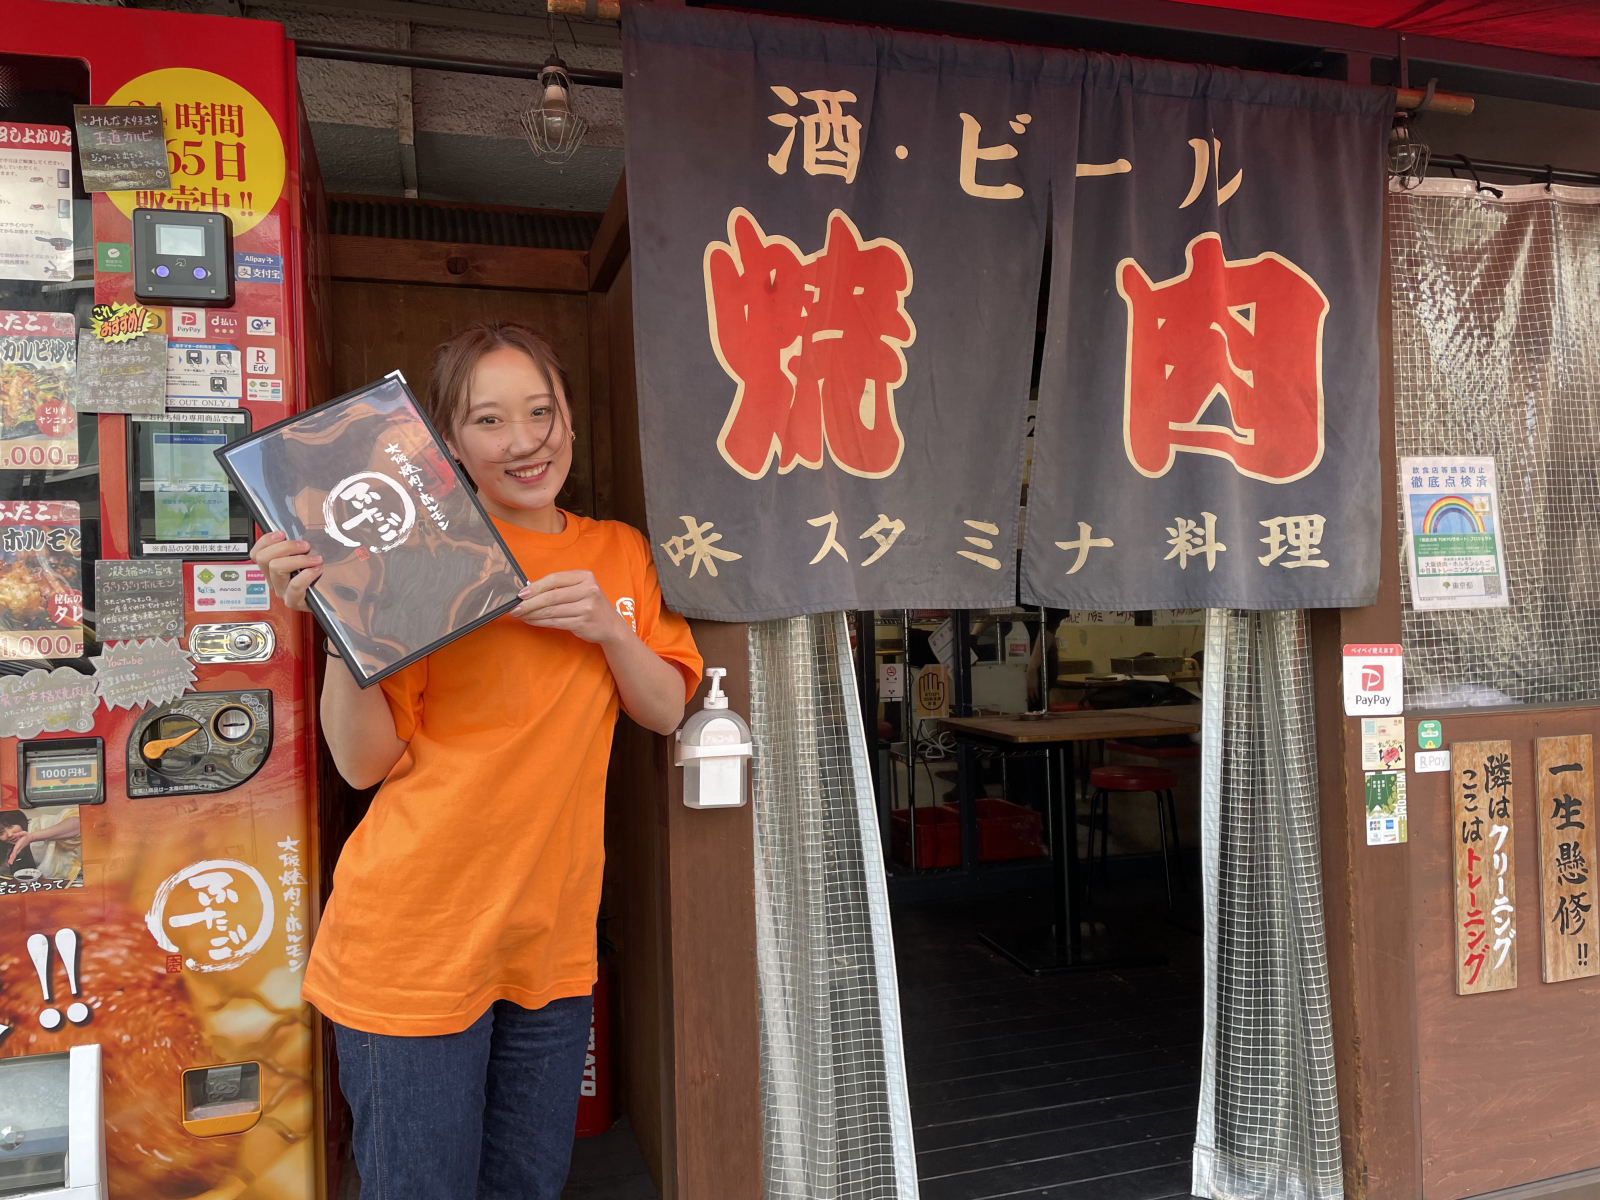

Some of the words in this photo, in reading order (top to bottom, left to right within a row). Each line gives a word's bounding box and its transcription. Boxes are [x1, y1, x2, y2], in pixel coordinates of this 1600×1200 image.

[93, 129, 154, 146] 王道カルビ
[767, 85, 1243, 209] 酒・ビール
[244, 255, 266, 264] Alipay
[94, 305, 113, 320] これ
[100, 308, 147, 338] おすすめ!
[211, 316, 239, 326] d払い
[177, 326, 202, 334] PayPay
[703, 206, 1332, 485] 焼肉
[256, 349, 267, 363] R
[253, 364, 269, 373] Edy
[1411, 475, 1488, 488] 徹底点検済
[1355, 694, 1392, 706] PayPay
[40, 767, 88, 778] 1000円札
[1484, 752, 1516, 970] 隣はクリーニング
[1462, 769, 1490, 985] ここはトレーニング
[277, 835, 307, 973] 大阪焼肉・ホルモン
